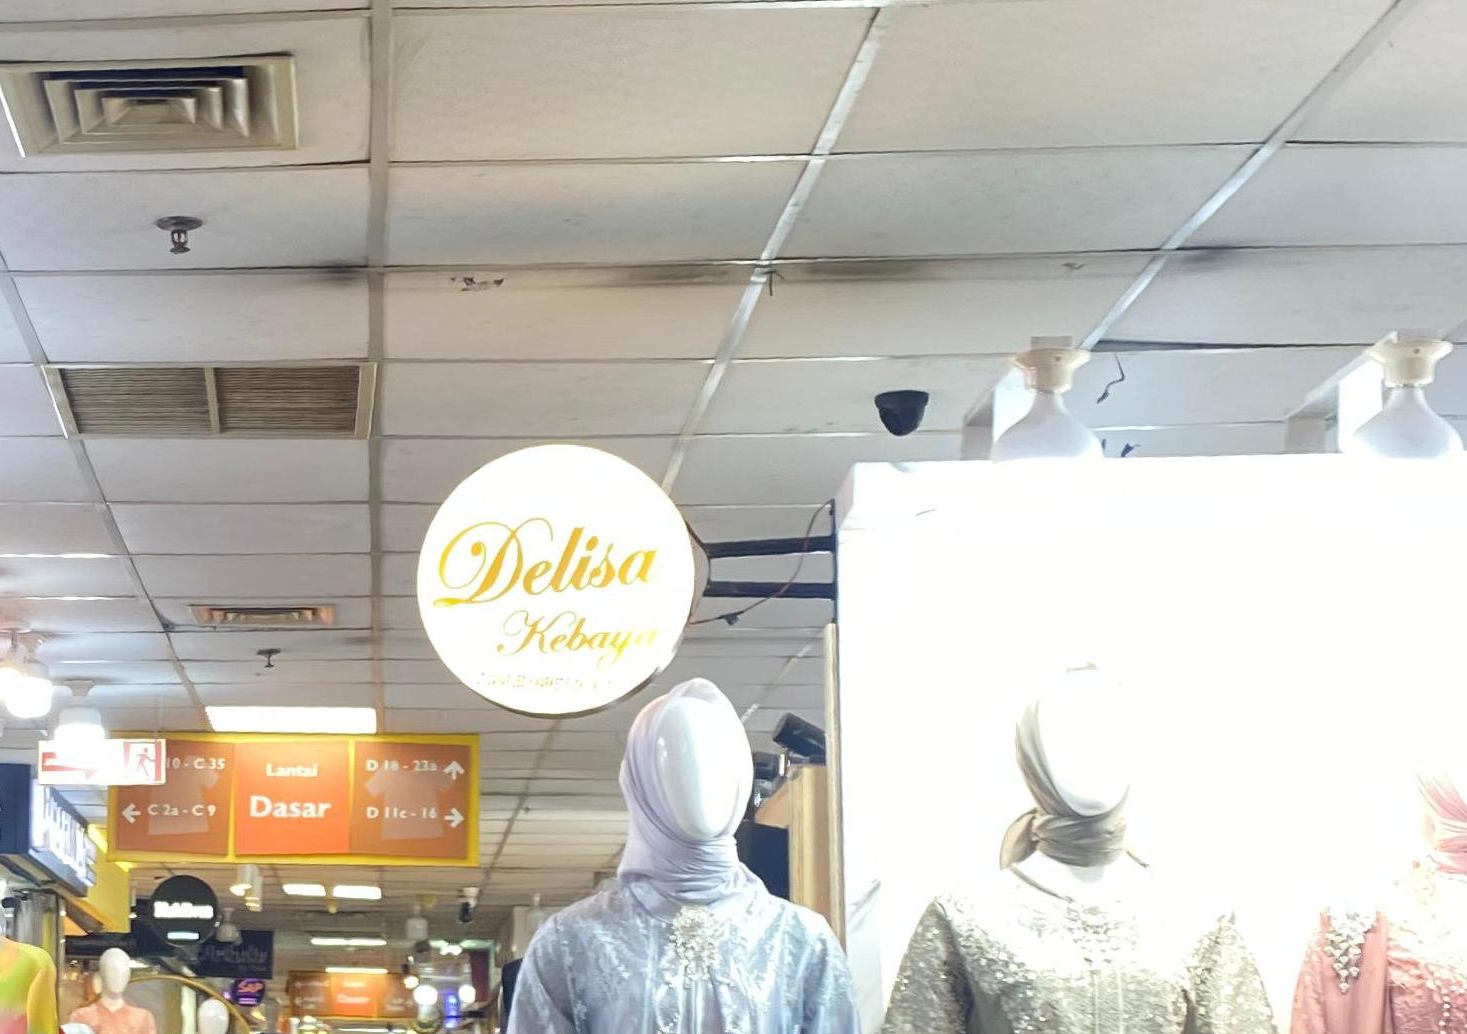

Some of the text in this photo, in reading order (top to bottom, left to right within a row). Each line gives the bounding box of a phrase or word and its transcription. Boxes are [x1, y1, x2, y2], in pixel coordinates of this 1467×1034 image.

[433, 517, 658, 607] Delisa
[496, 610, 659, 670] Kebaya
[193, 757, 205, 770] C
[209, 757, 226, 770] 35
[265, 762, 319, 777] Lantai
[365, 759, 379, 772] D
[147, 804, 160, 817] C
[191, 804, 205, 817] C
[207, 804, 217, 817] 9
[249, 794, 333, 819] Dasar
[365, 806, 379, 819] D
